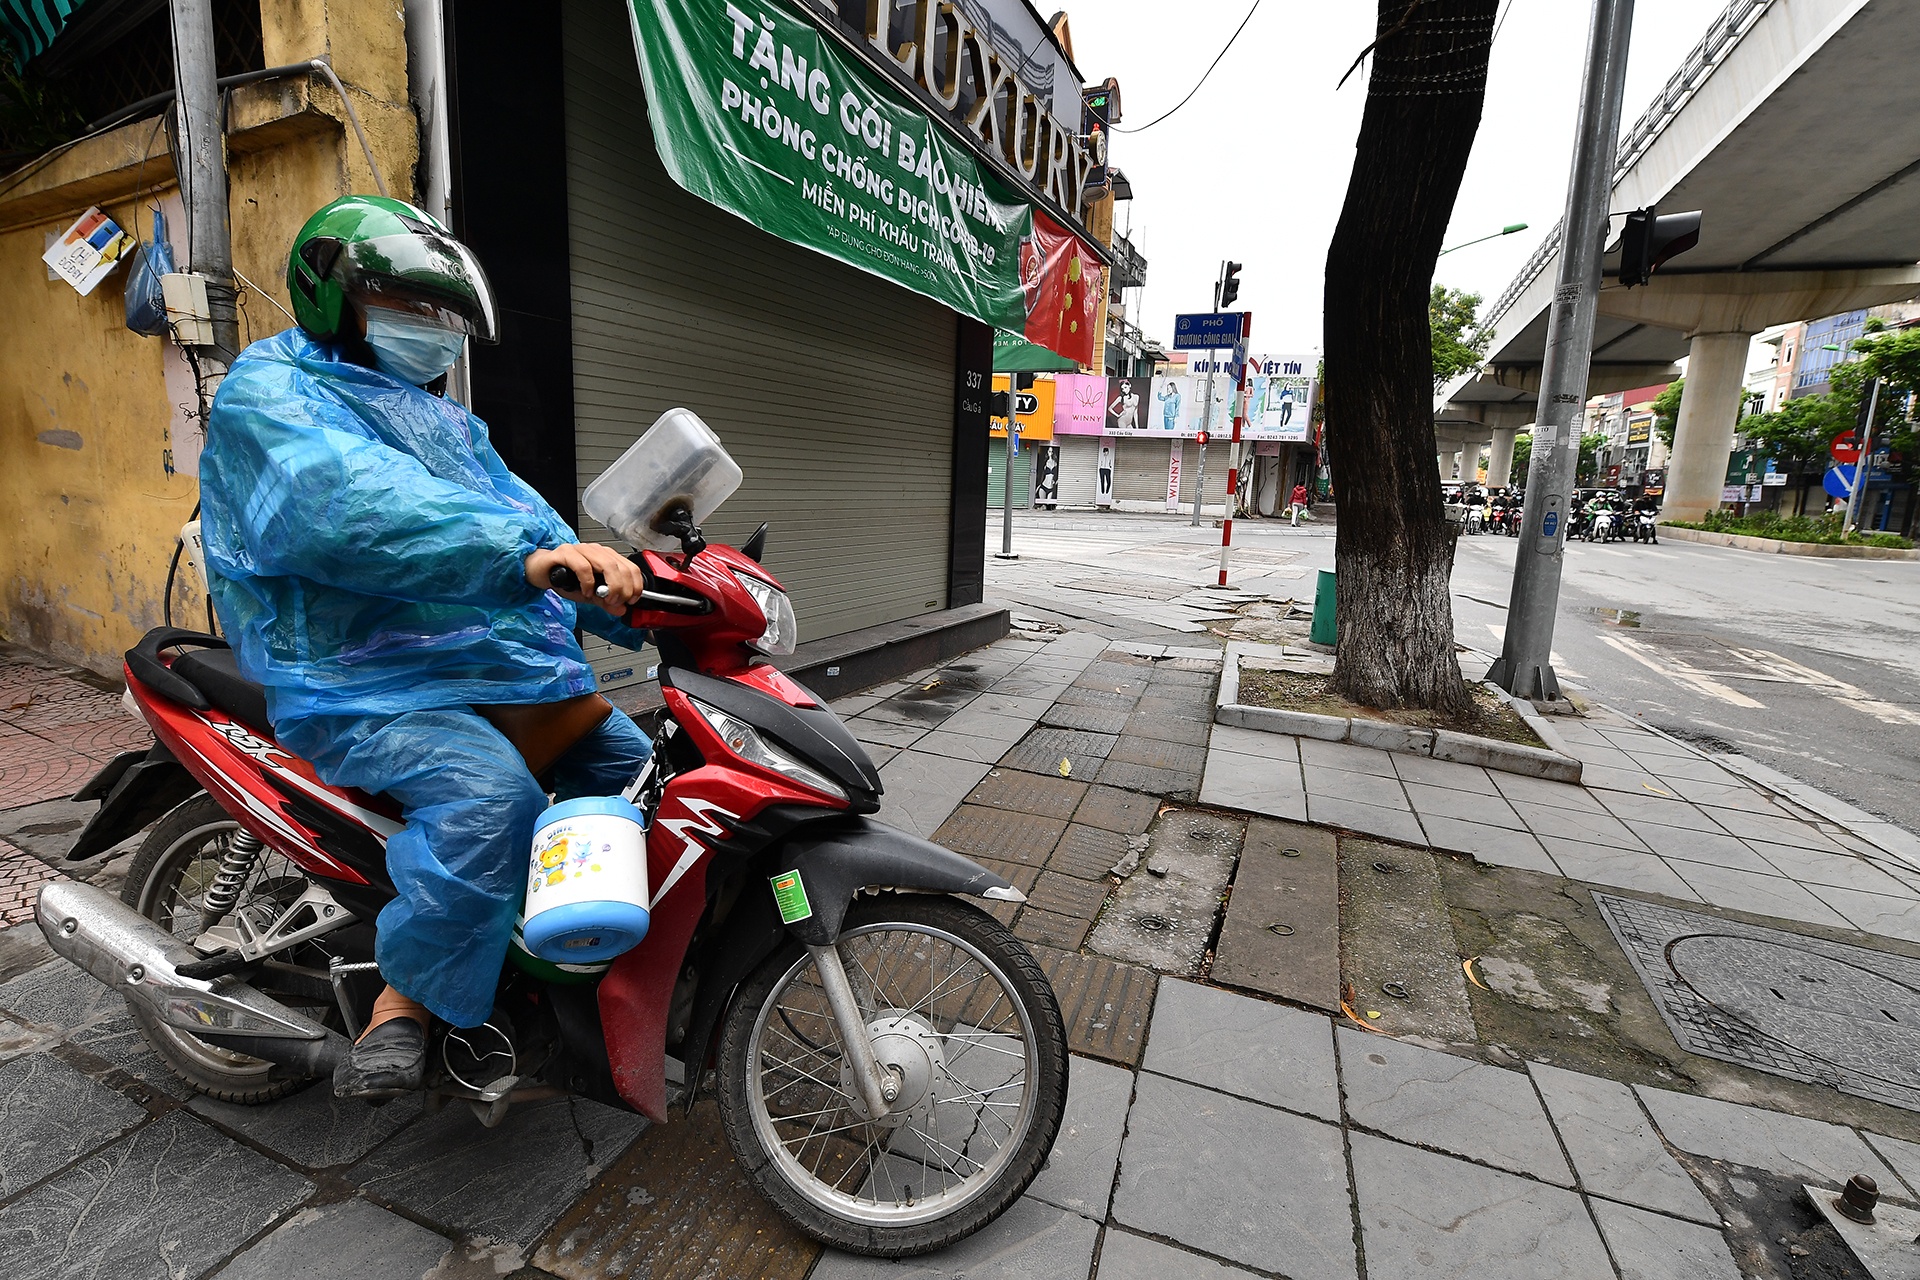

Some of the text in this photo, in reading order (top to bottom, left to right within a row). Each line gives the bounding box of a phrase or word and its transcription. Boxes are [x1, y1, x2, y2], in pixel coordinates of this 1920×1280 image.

[726, 1, 830, 115] TẶNG
[840, 91, 892, 157] GÓI
[897, 131, 951, 194] BẢO
[868, 0, 1094, 225] LUXURY
[722, 77, 817, 160] PHÒNG
[821, 143, 894, 205] CHỐNG
[898, 187, 939, 231] DỊCH
[802, 177, 959, 275] MIỄN PHÍ KHẨU TRANG
[865, 243, 882, 258] CHO
[1202, 316, 1224, 327] PHỐ
[1176, 333, 1202, 345] TRƯƠNG
[1203, 332, 1220, 345] CÔNG
[966, 370, 983, 389] 337
[1284, 360, 1302, 374] TÍN
[1072, 414, 1102, 423] WINNY
[1169, 457, 1180, 499] WINNY
[210, 720, 293, 769] RSX
